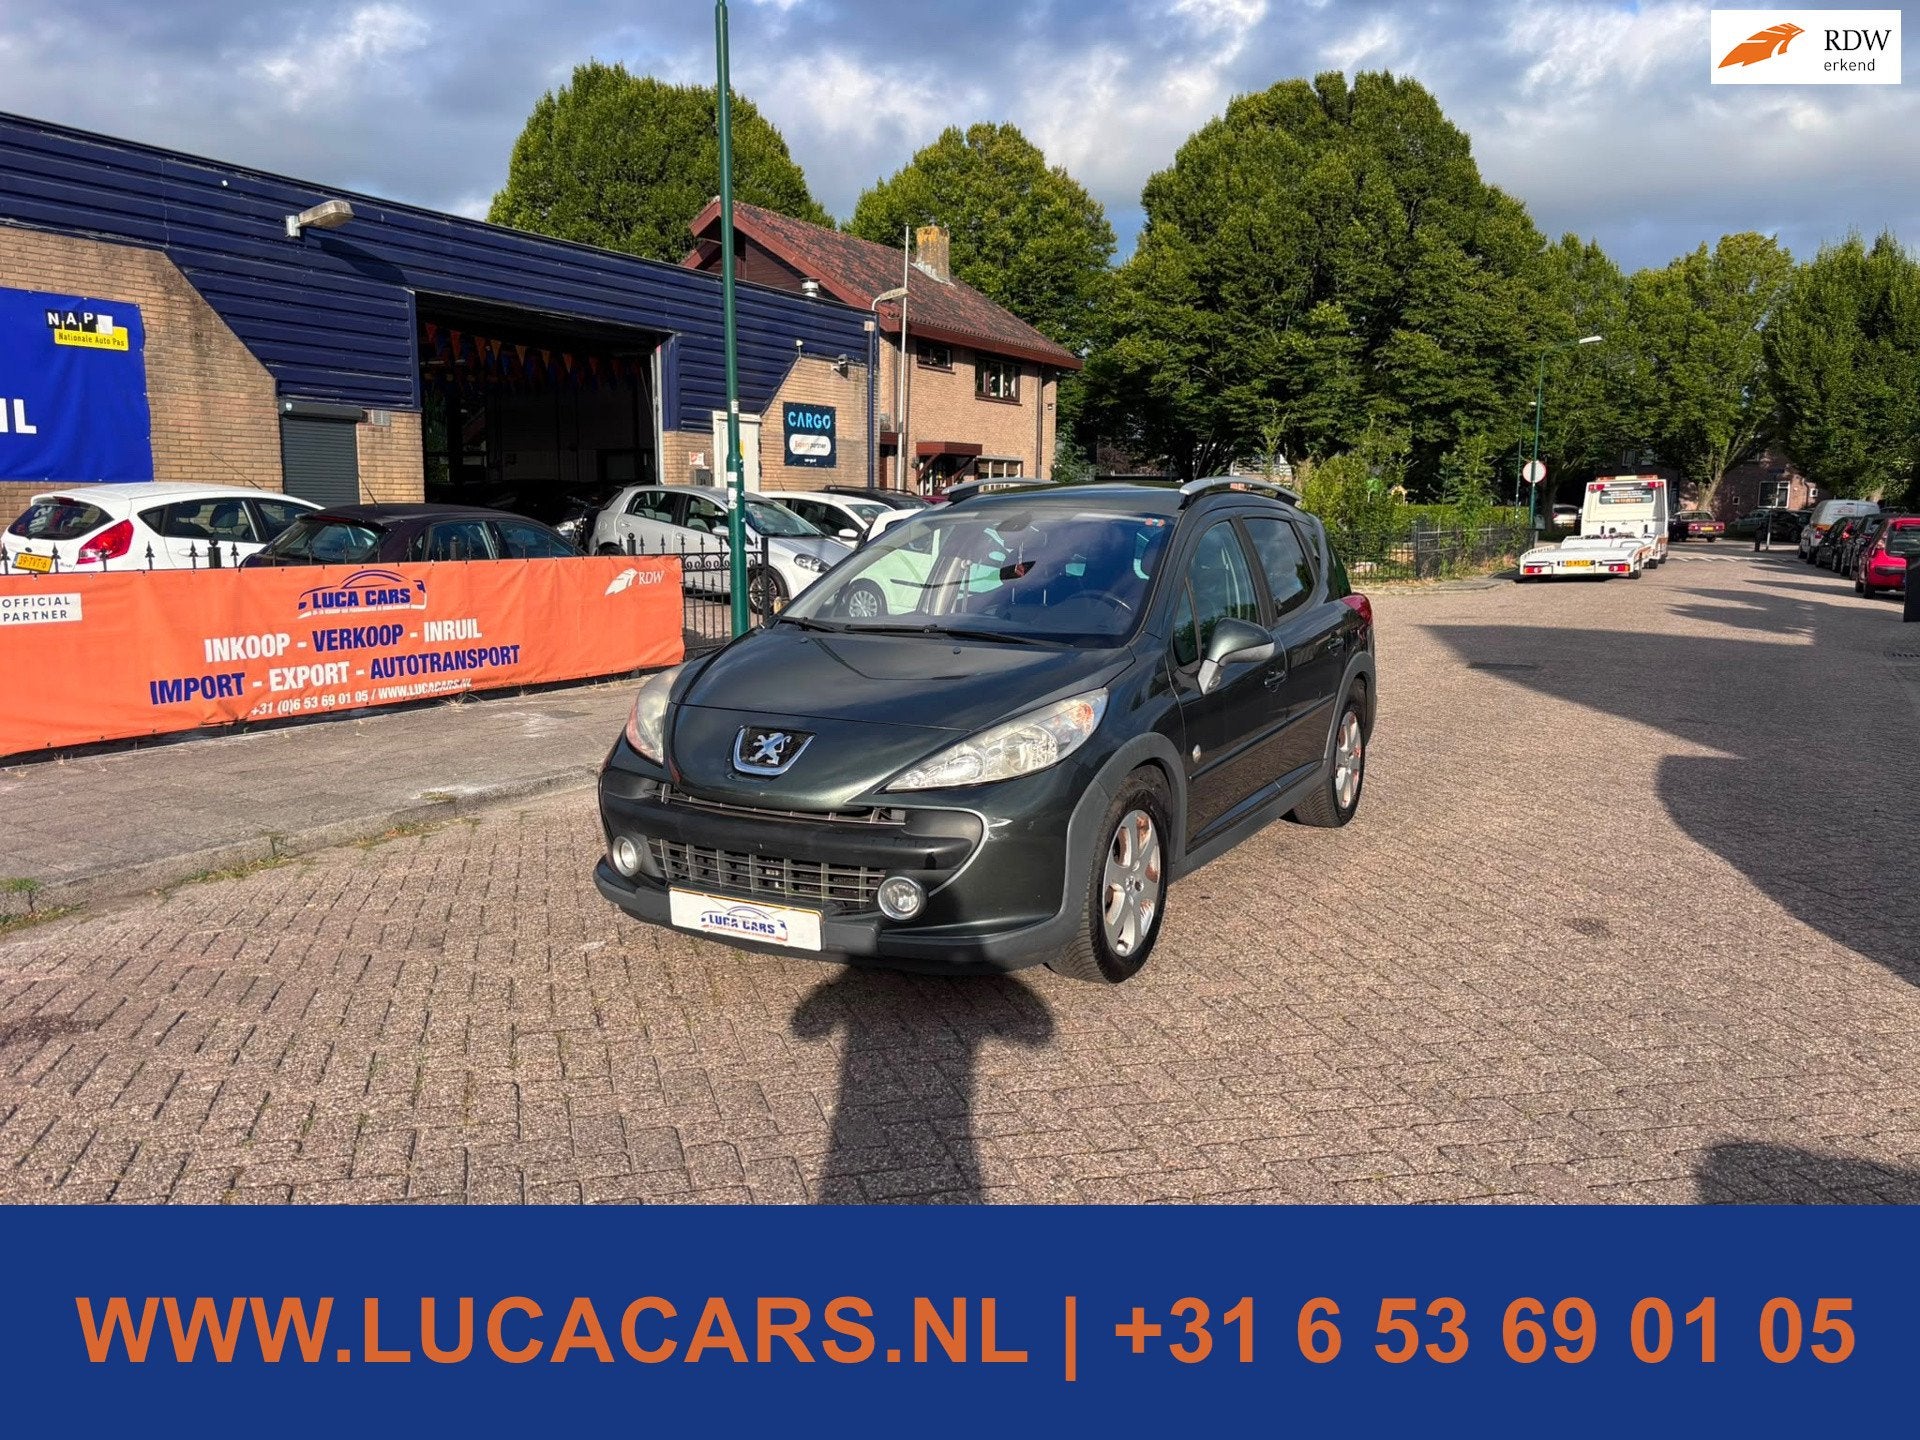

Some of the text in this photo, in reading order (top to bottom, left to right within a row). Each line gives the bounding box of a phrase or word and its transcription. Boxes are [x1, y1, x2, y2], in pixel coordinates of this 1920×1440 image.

[58, 332, 125, 347] Nationale Auto Pas
[788, 411, 831, 430] CARGO
[638, 570, 666, 585] RDW
[2, 595, 71, 608] OFFICIAL
[312, 588, 411, 609] LUCA CARS
[3, 609, 68, 622] PARTNER
[203, 632, 291, 663] INKOOP
[312, 623, 404, 653] VERKOOP
[423, 617, 483, 643] INRUIL
[150, 671, 245, 705] IMPORT
[269, 660, 350, 692] EXPORT
[370, 644, 520, 680] AUTOTRANSPORT
[251, 700, 274, 717] +31
[303, 696, 318, 709] 53
[321, 693, 335, 707] 69
[338, 691, 351, 705] 01
[354, 690, 369, 703] 05
[709, 914, 739, 928] LUCA
[742, 920, 775, 935] CARS
